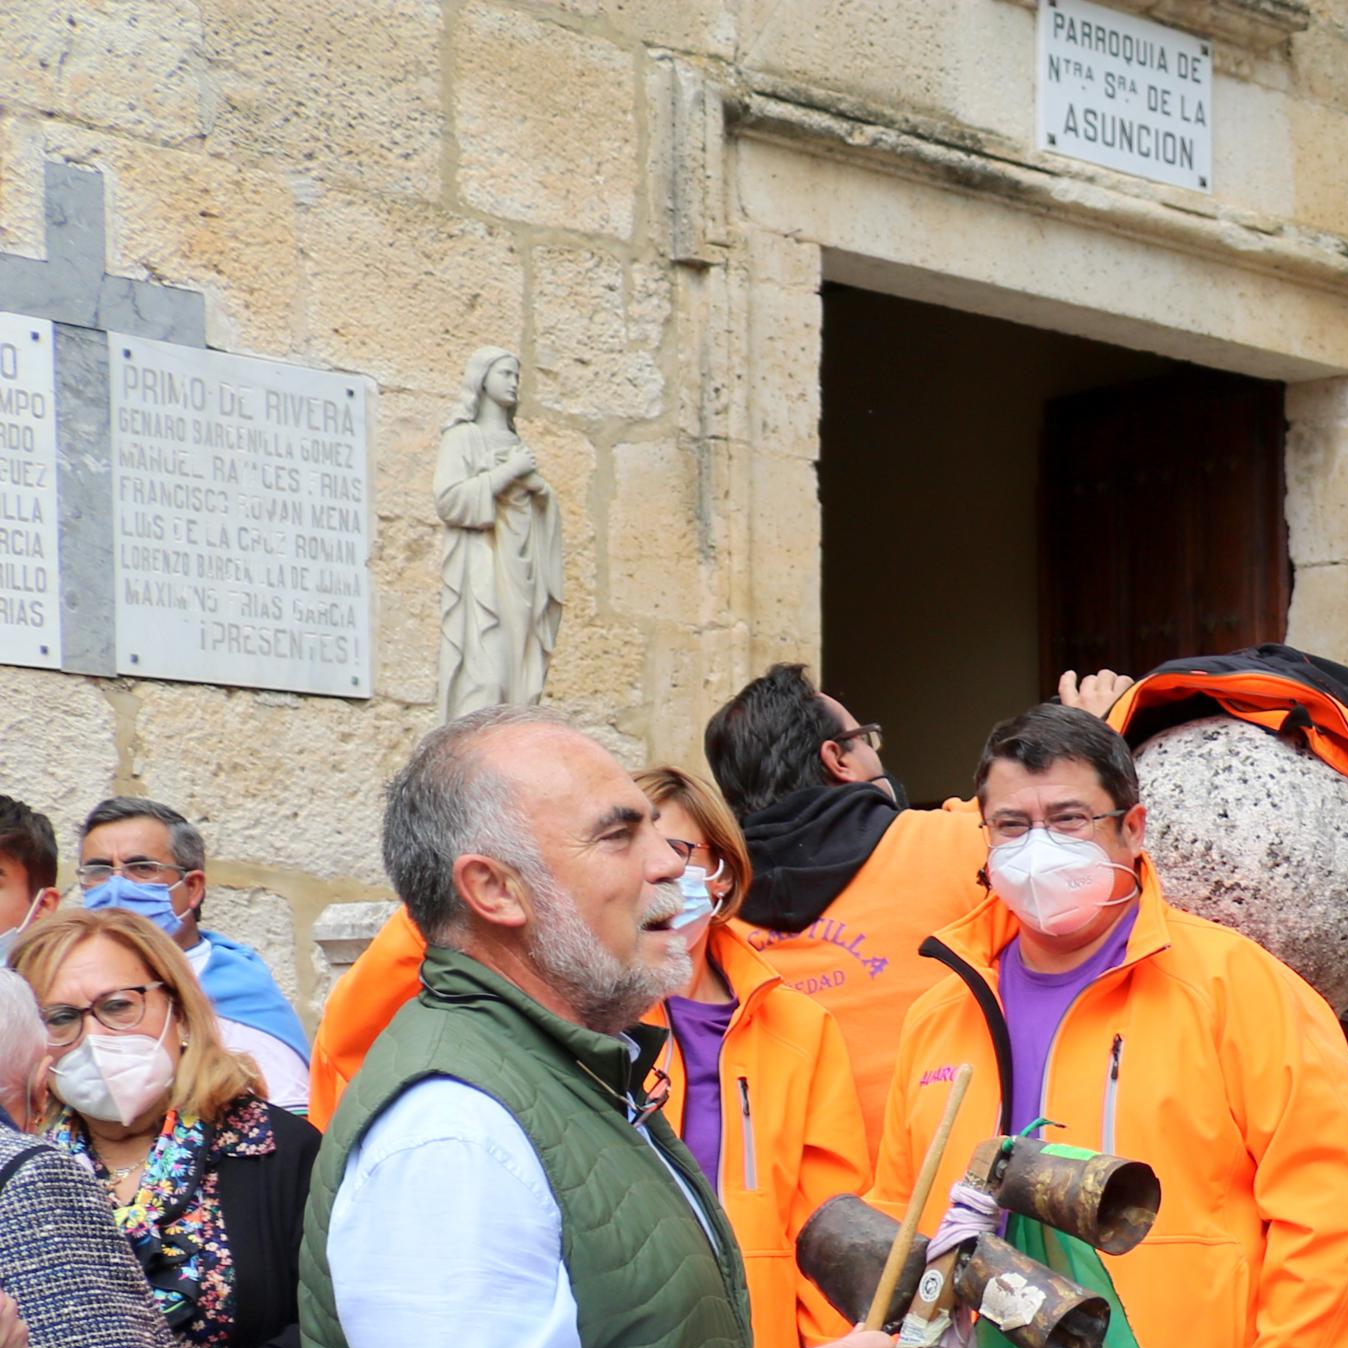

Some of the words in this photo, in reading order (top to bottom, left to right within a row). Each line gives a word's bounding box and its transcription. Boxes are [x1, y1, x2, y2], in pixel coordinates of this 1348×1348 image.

[1053, 12, 1168, 73] PARROQUIA
[1178, 52, 1202, 84] DE
[1064, 104, 1194, 170] ASUNCION
[1148, 85, 1171, 117] DE
[1181, 95, 1206, 127] LA
[123, 364, 206, 412] PRIMO
[219, 380, 253, 420] DE
[265, 389, 356, 437] RIVERA
[118, 406, 186, 443] GENARO
[300, 438, 354, 469] GOMEZ
[119, 475, 228, 516] FRANCISCO
[311, 504, 361, 534] MENA
[121, 543, 190, 577] LORENZO
[291, 565, 310, 591] DE
[748, 918, 888, 980] CATILLA
[788, 970, 846, 995] EDAD
